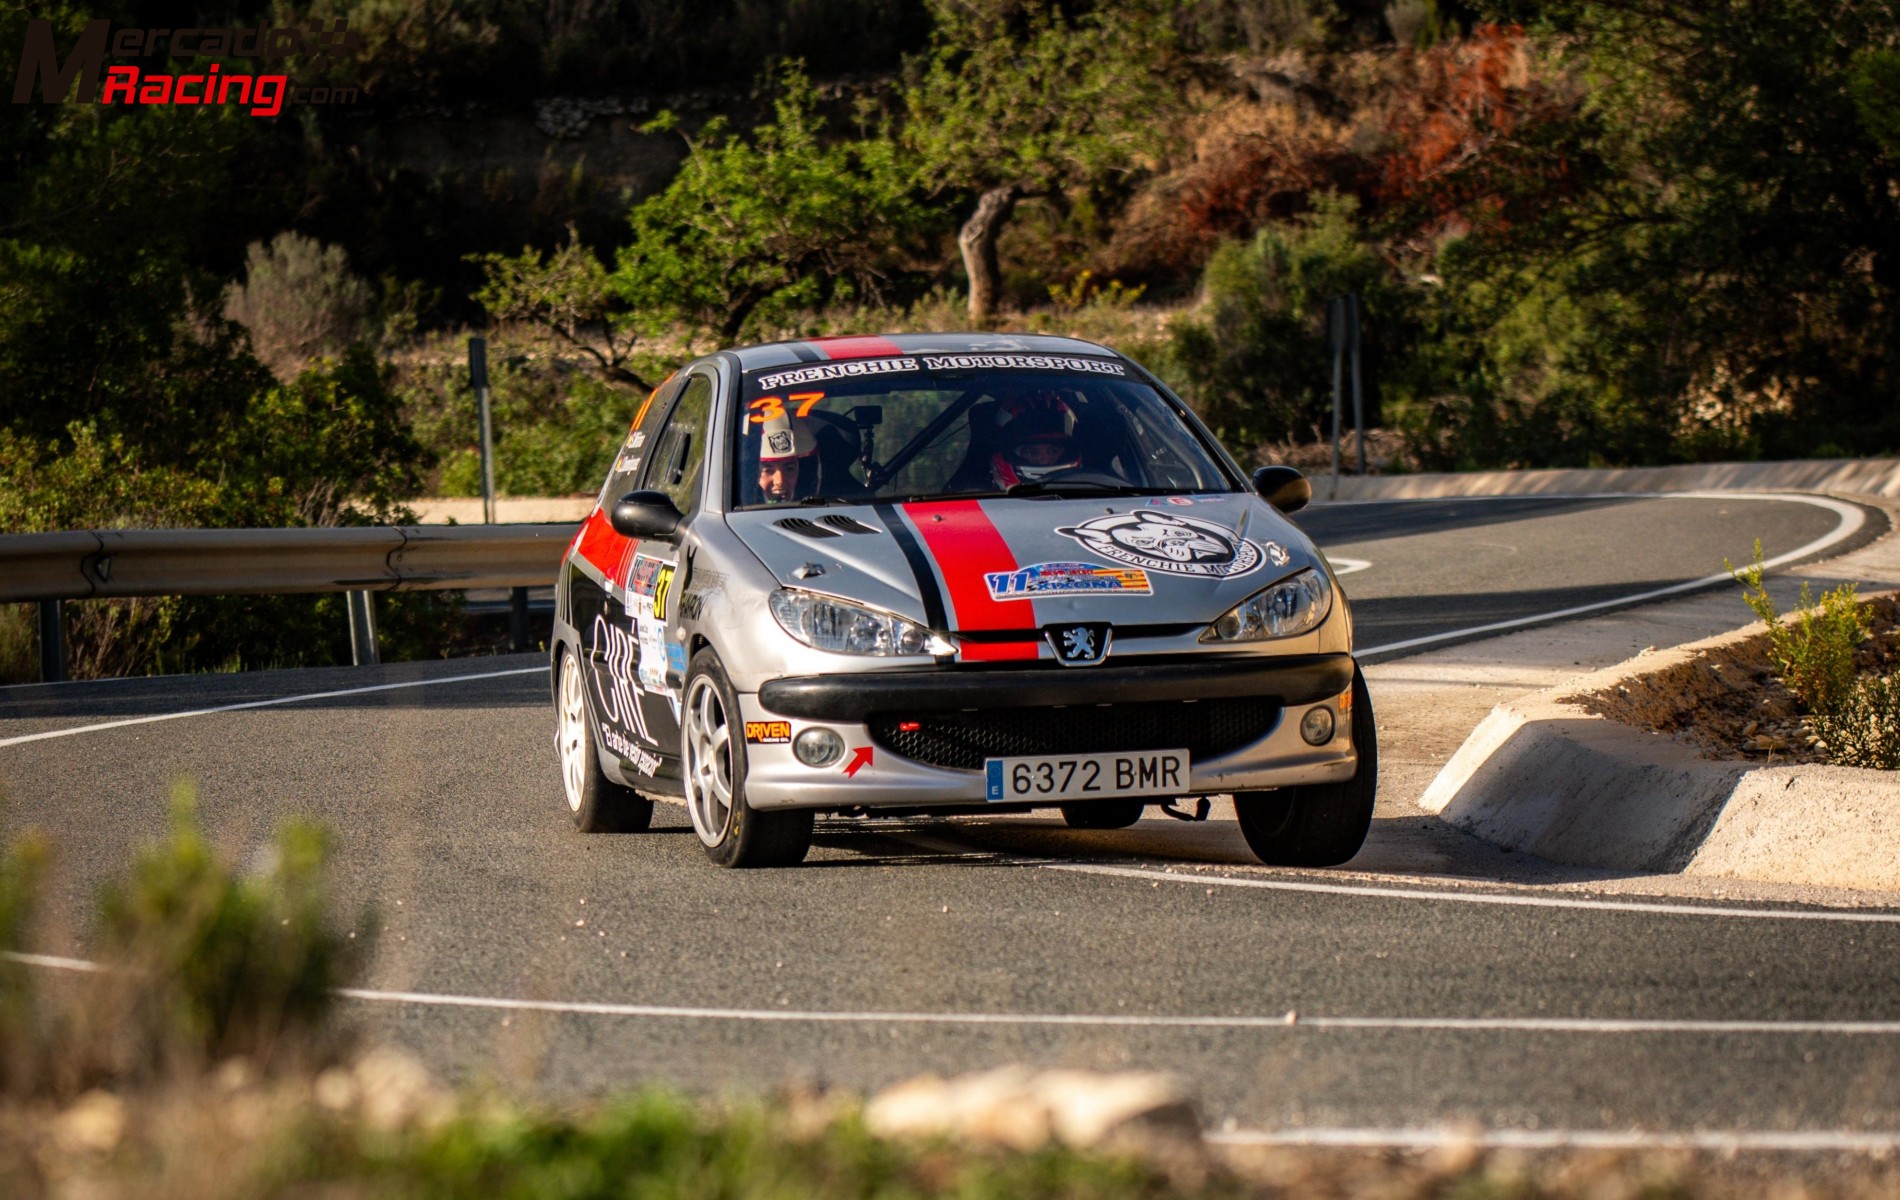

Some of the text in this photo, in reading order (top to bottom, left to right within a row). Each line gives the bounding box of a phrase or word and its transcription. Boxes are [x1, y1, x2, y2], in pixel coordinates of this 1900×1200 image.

[759, 355, 1126, 390] FRENCHIE MOTORSPORT
[750, 392, 825, 424] 37
[1099, 545, 1196, 573] FRENCHIE
[654, 568, 675, 619] 37
[993, 573, 1030, 594] 11
[1036, 580, 1124, 591] XIXONA
[746, 722, 790, 743] DRIVEN
[1012, 755, 1181, 795] 6372 BMR
[991, 785, 999, 796] E
